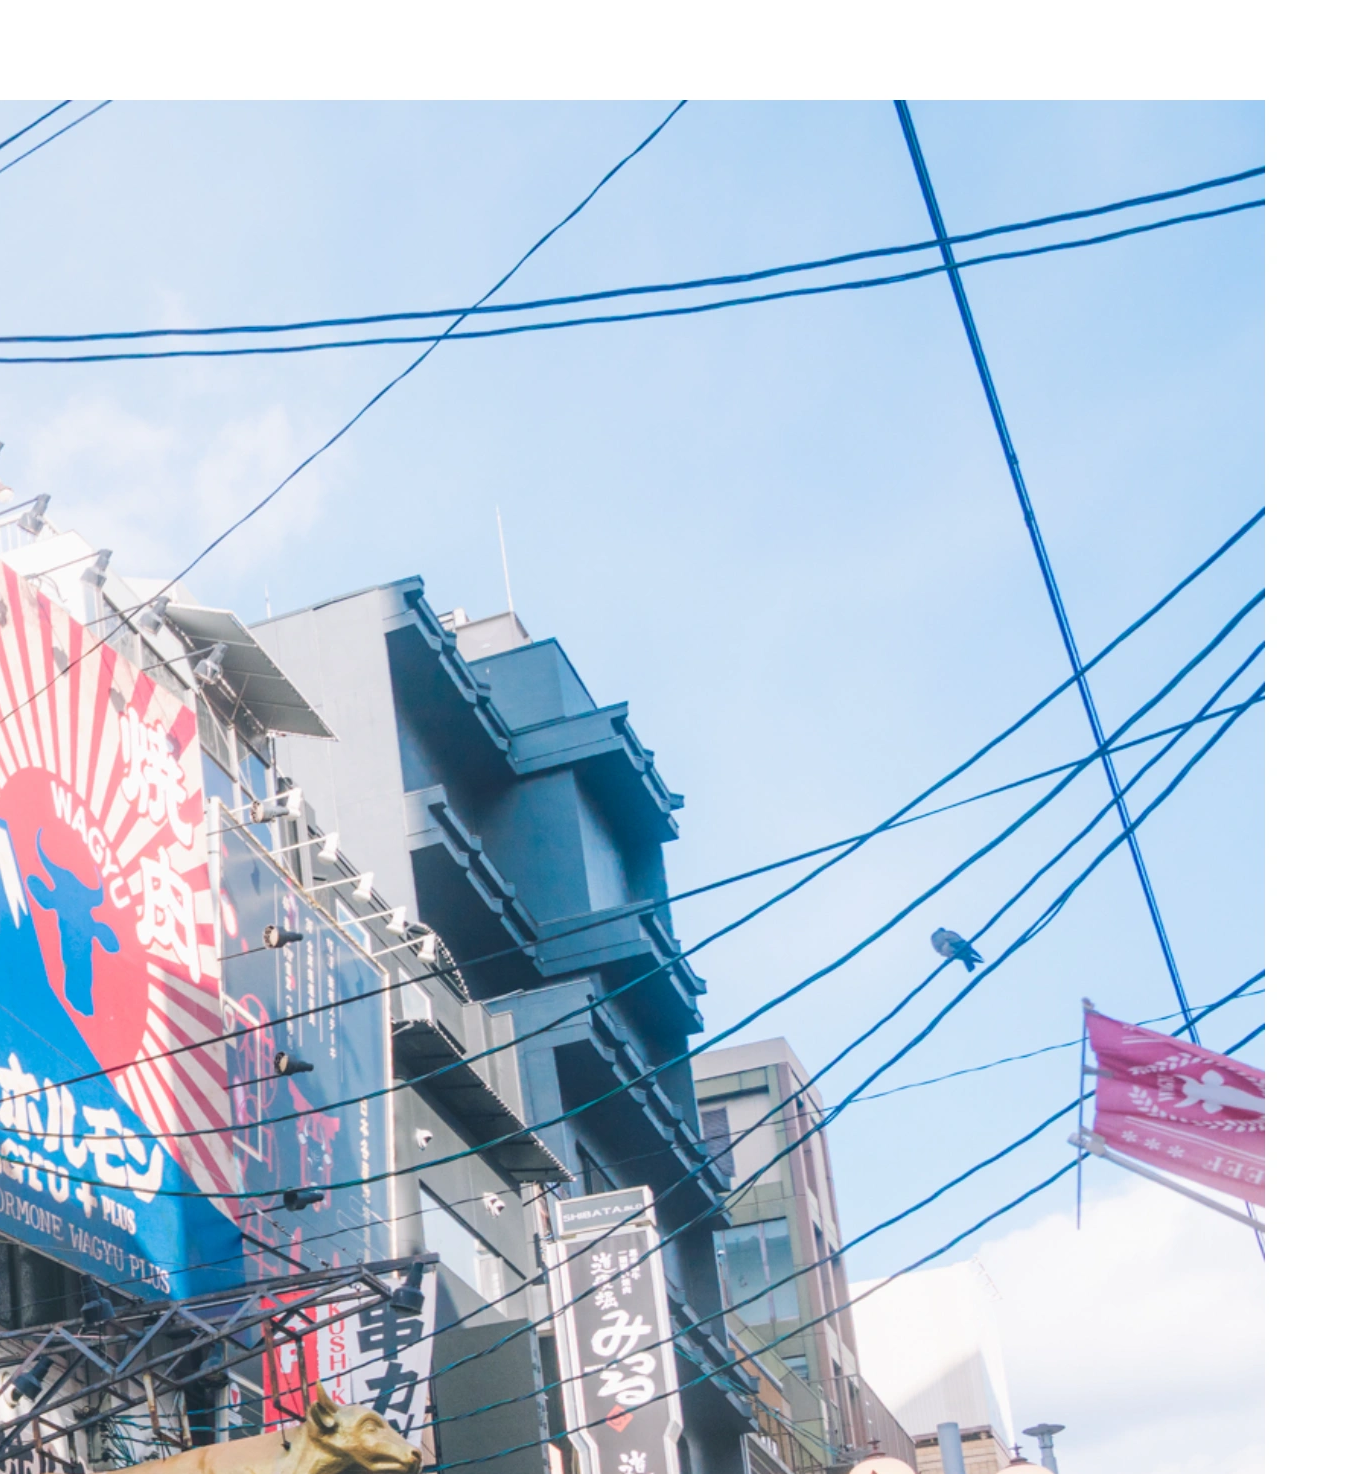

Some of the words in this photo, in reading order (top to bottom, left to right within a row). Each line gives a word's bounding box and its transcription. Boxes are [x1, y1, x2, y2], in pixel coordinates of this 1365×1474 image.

[50, 779, 131, 910] WAGYU
[101, 1194, 137, 1236] PLUS
[68, 1222, 125, 1272] WAGYU
[129, 1254, 171, 1294] PLUS
[582, 1308, 657, 1407] みつる
